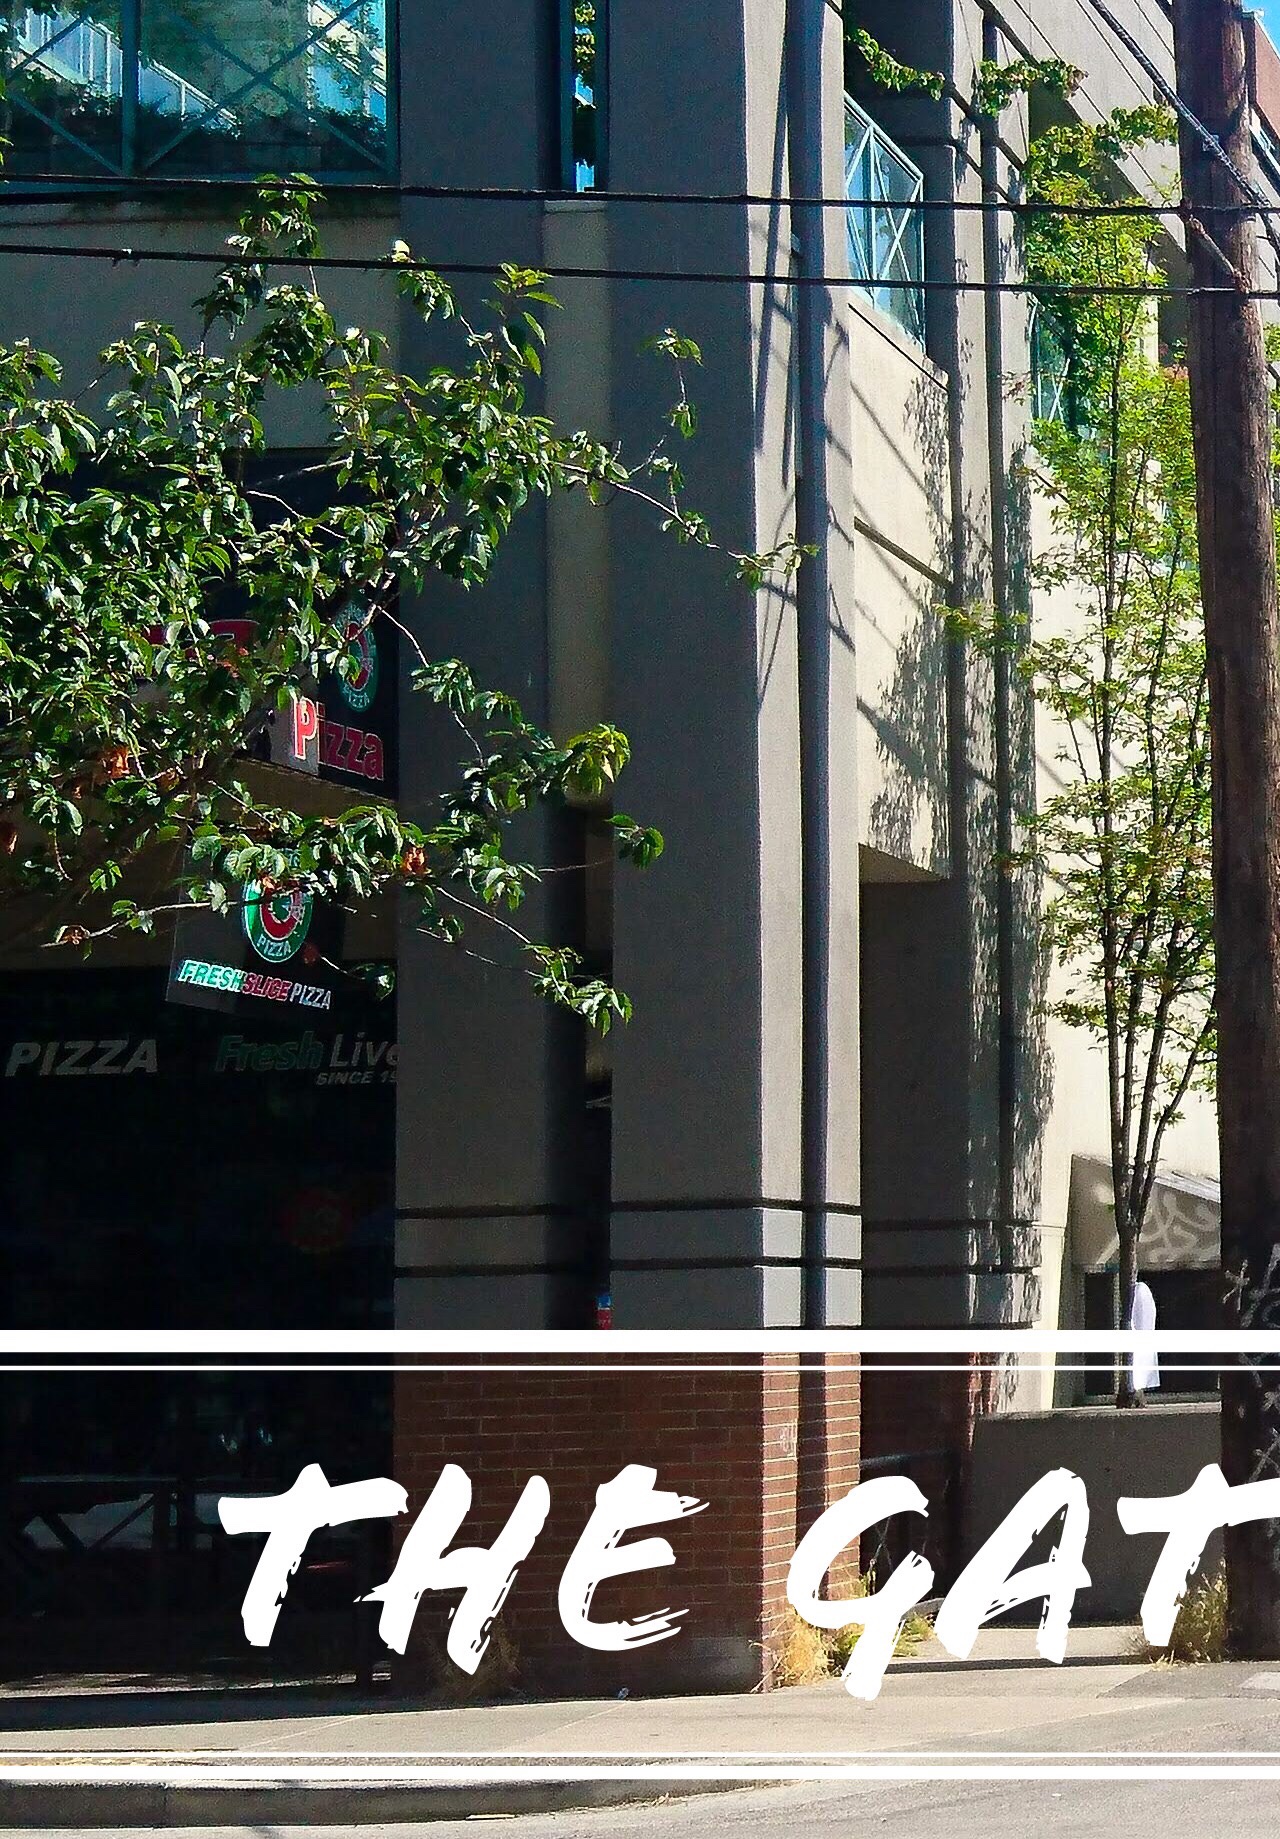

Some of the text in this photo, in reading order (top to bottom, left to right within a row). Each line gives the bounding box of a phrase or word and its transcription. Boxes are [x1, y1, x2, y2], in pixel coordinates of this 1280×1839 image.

[292, 697, 384, 781] Pizza
[256, 932, 292, 958] PIZZA
[289, 982, 333, 1010] PIZZA
[4, 1038, 160, 1078] PIZZA
[213, 1030, 325, 1072] Fresh
[315, 1071, 374, 1086] SINCE
